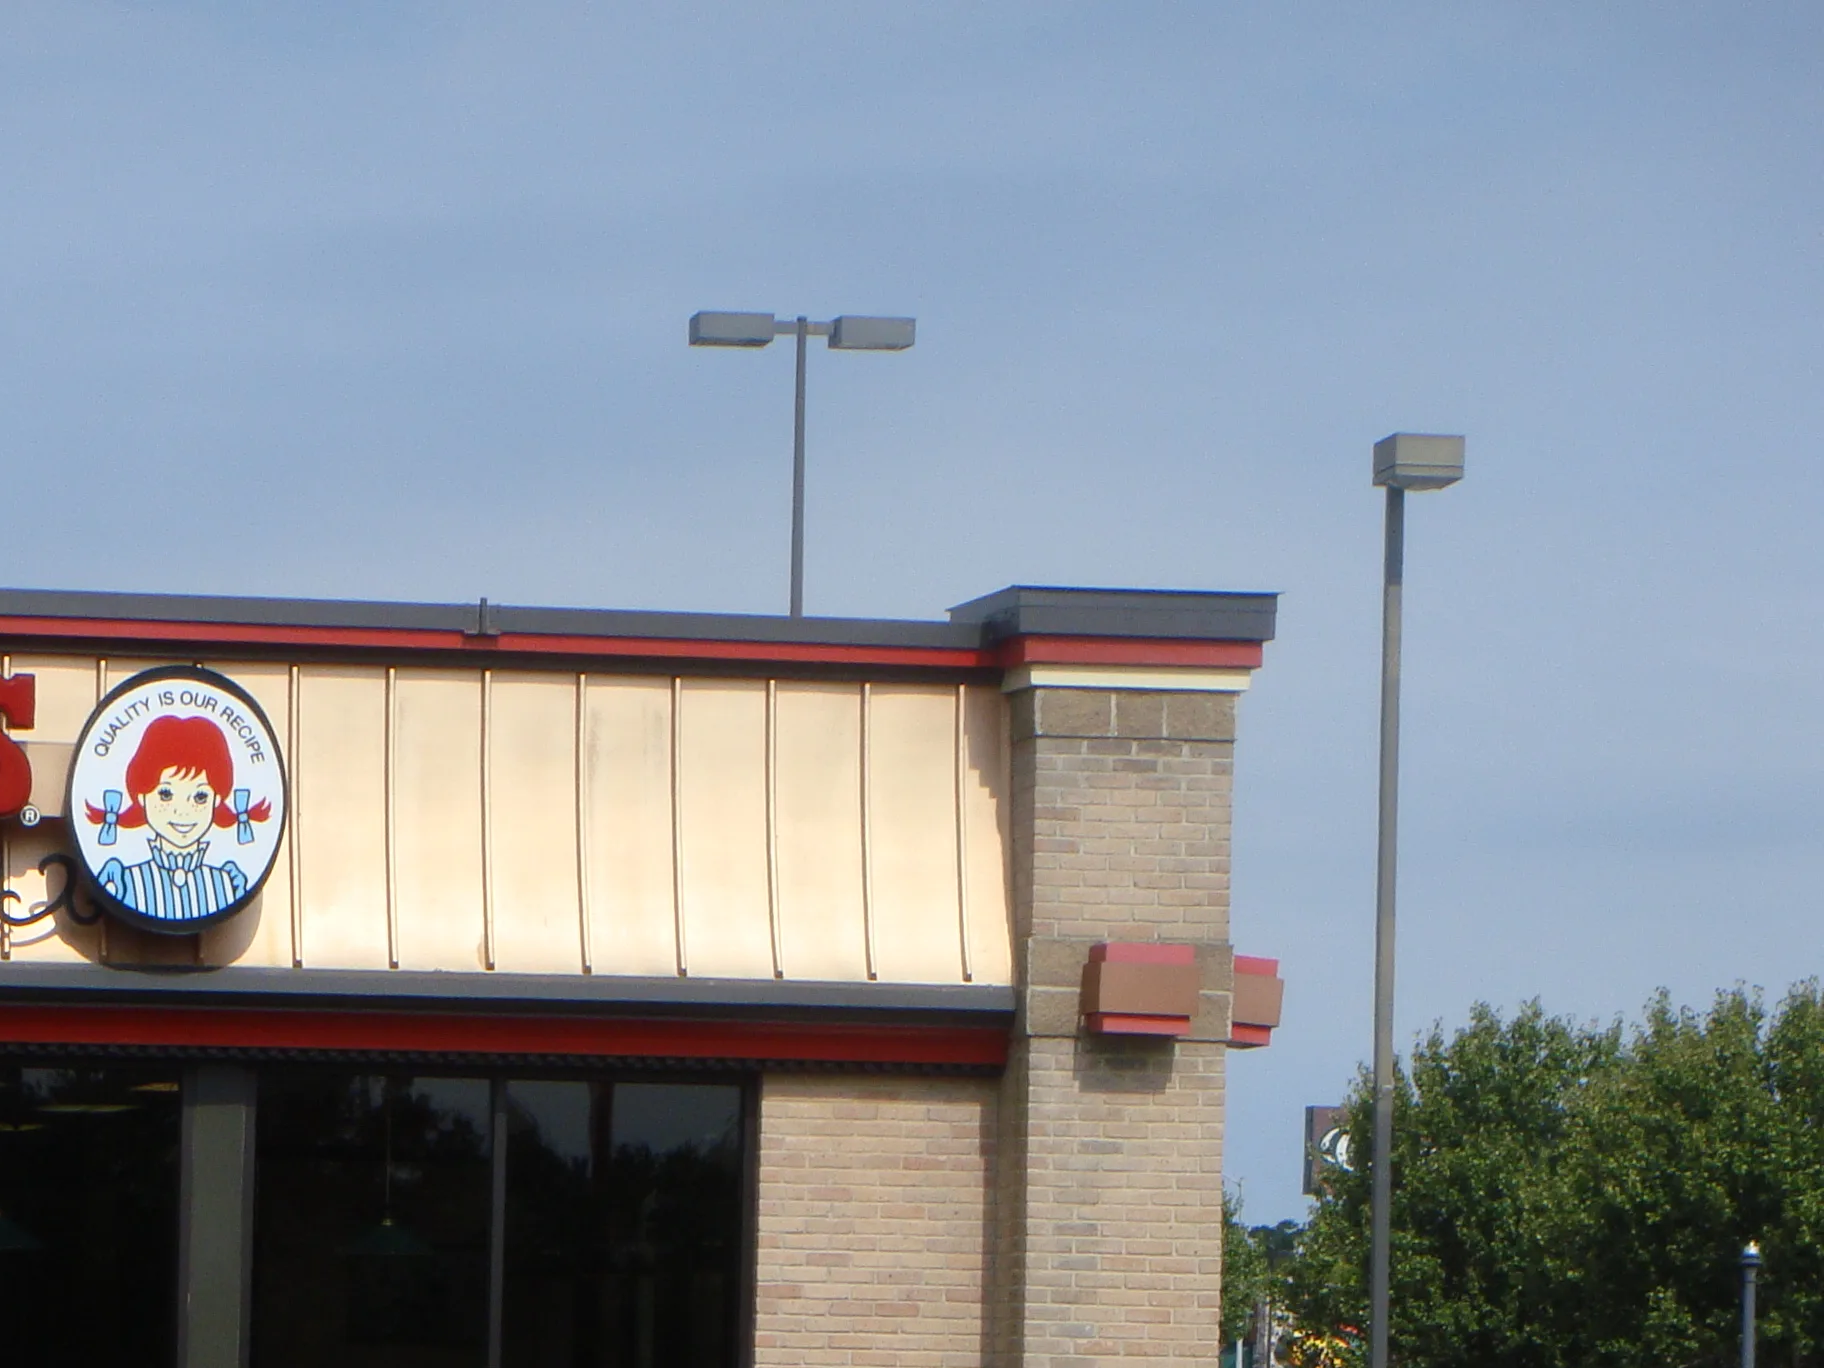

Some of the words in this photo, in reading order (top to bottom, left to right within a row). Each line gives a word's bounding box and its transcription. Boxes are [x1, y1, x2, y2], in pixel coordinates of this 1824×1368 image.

[94, 697, 151, 757] QUALITY
[158, 691, 175, 707] IS
[180, 690, 218, 713] OUR
[219, 706, 265, 764] RECIPE
